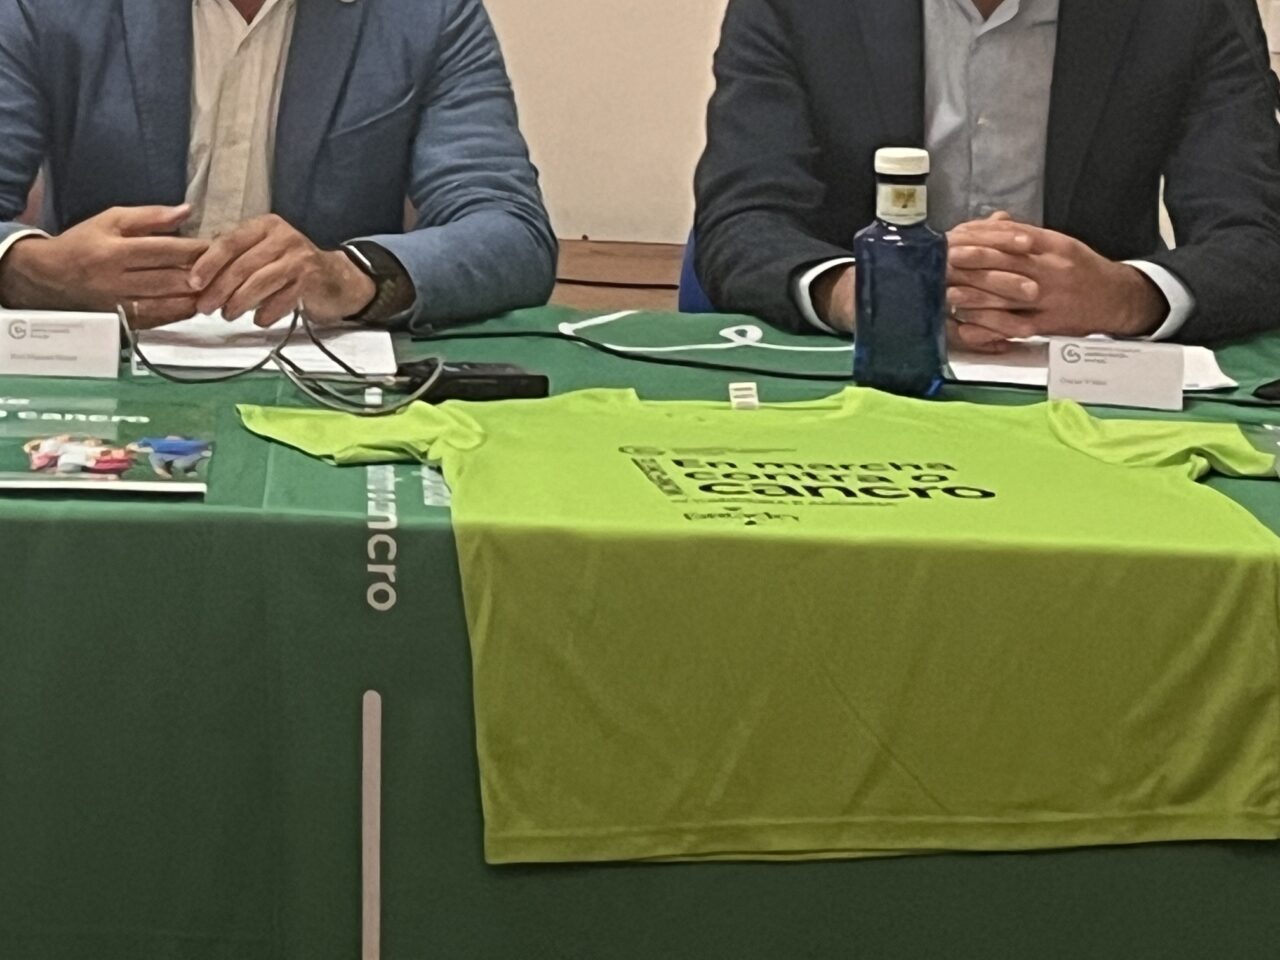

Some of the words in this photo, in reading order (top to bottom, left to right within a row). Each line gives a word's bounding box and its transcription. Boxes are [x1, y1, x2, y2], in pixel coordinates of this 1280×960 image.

[671, 458, 738, 469] En
[752, 461, 958, 472] marcha
[683, 470, 895, 484] contra
[911, 473, 949, 483] o
[697, 482, 997, 500] cancro
